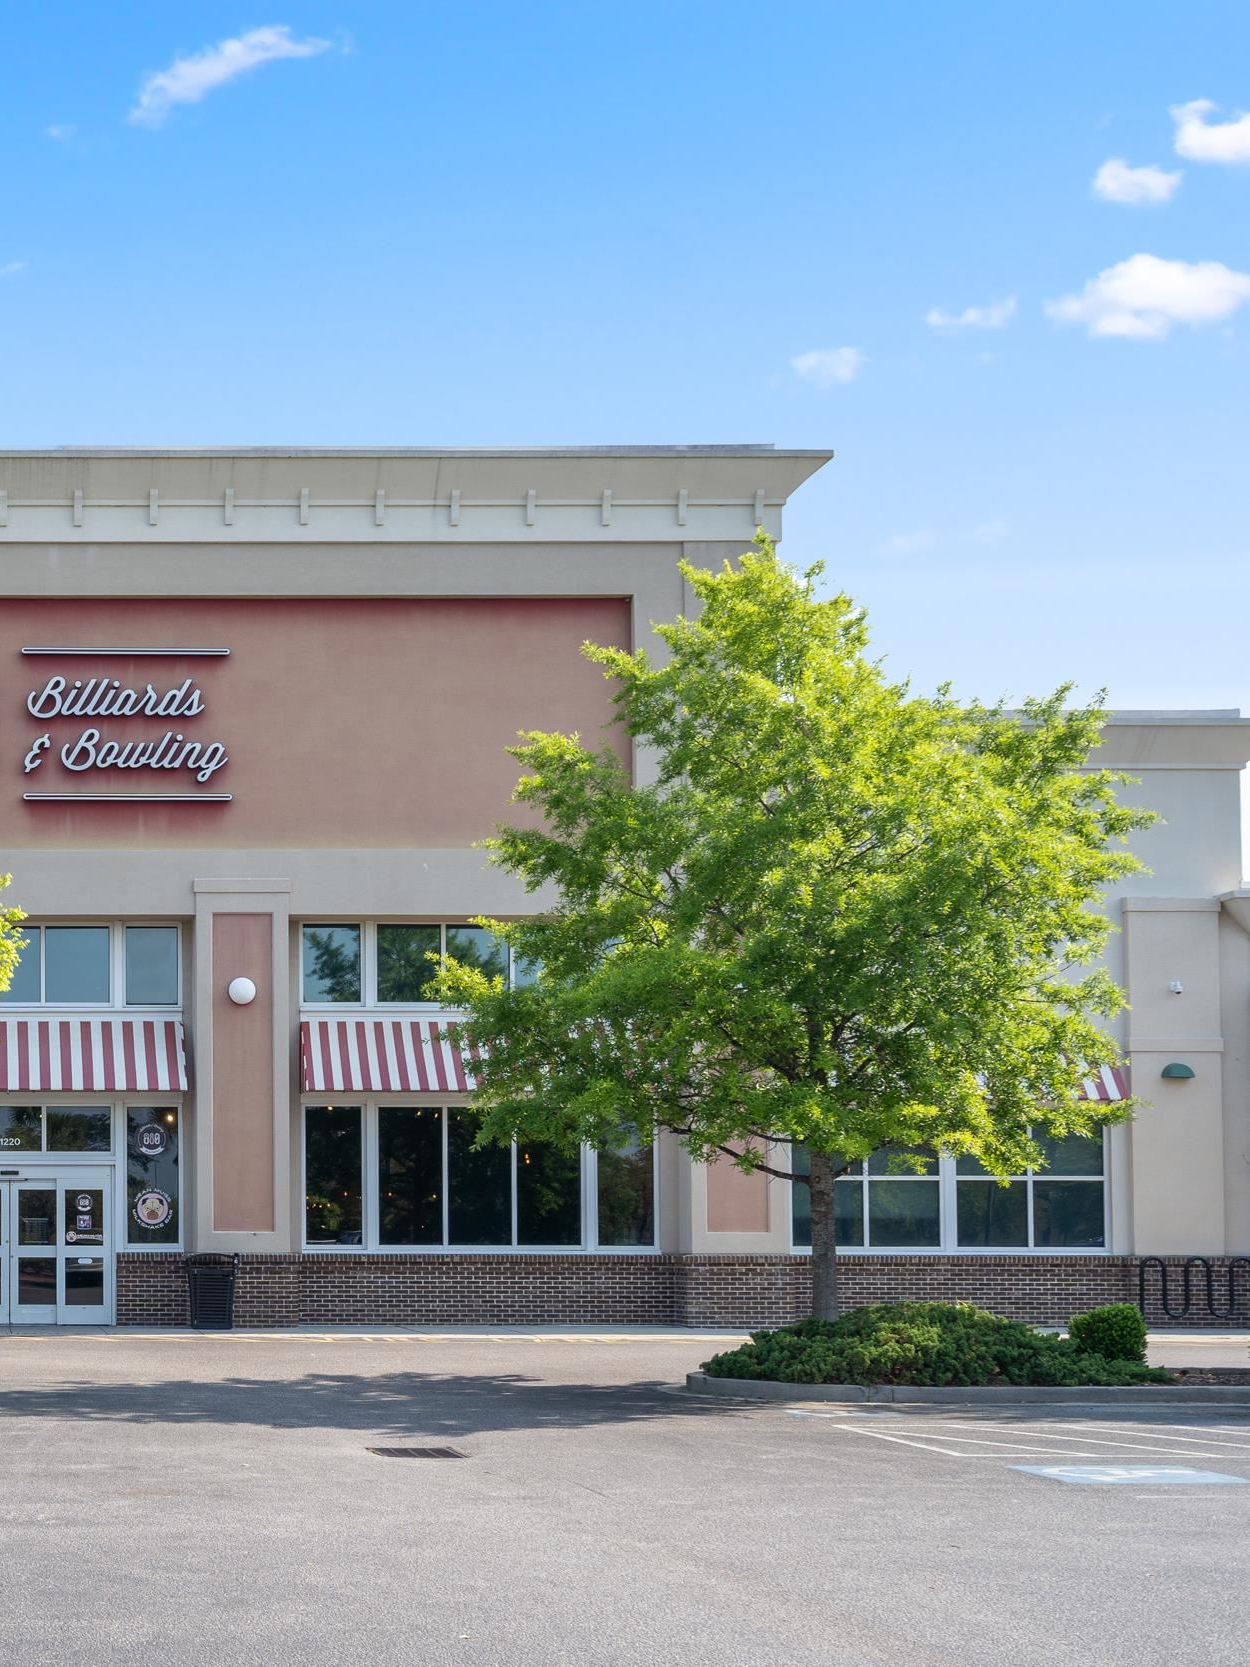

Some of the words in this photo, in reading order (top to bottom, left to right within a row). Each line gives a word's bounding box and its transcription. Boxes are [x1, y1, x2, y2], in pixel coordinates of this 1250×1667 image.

[27, 675, 205, 719] Billiards
[24, 733, 50, 773] &
[61, 728, 229, 783] Bowling
[0, 1137, 21, 1146] 1220
[133, 1188, 152, 1202] MEAN
[132, 1209, 165, 1229] MILKSHAKE
[164, 1209, 173, 1224] BAR
